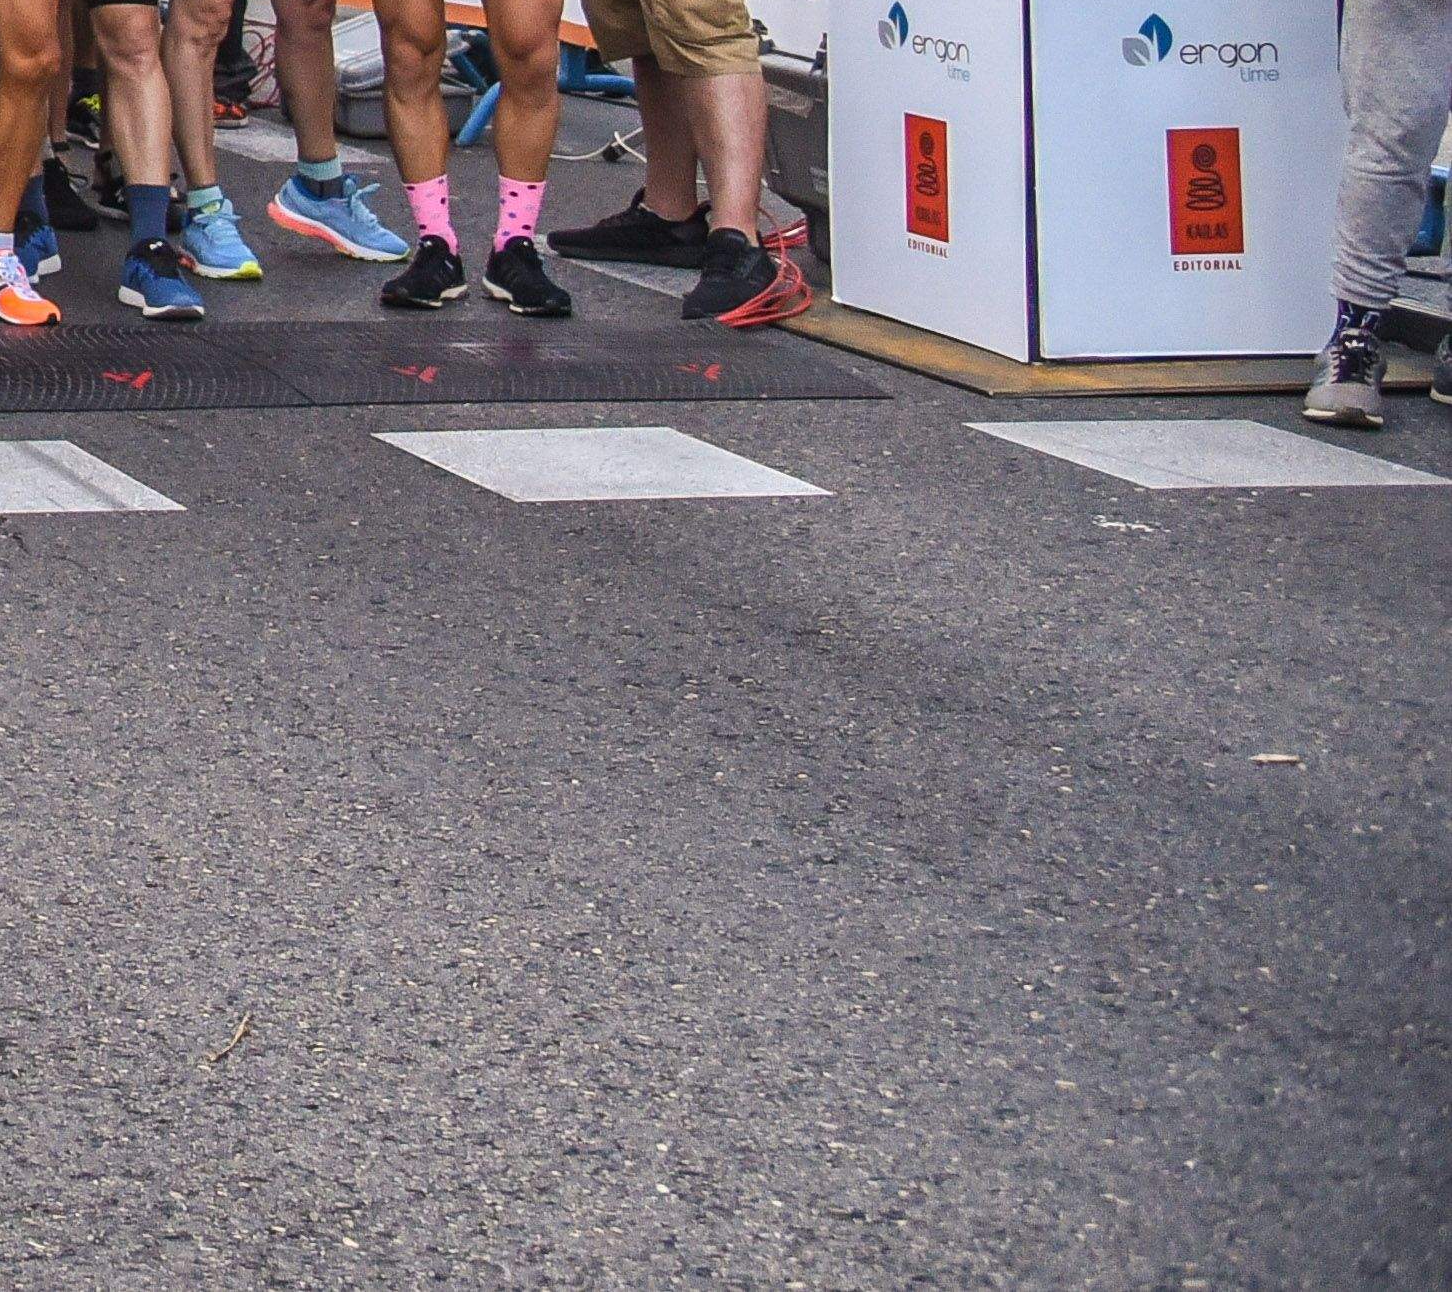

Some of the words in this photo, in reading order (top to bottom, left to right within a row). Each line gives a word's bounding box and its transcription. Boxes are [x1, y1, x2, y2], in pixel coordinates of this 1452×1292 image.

[1179, 37, 1279, 69] ergon
[1239, 65, 1280, 82] time
[1173, 260, 1243, 272] EDITORIAL
